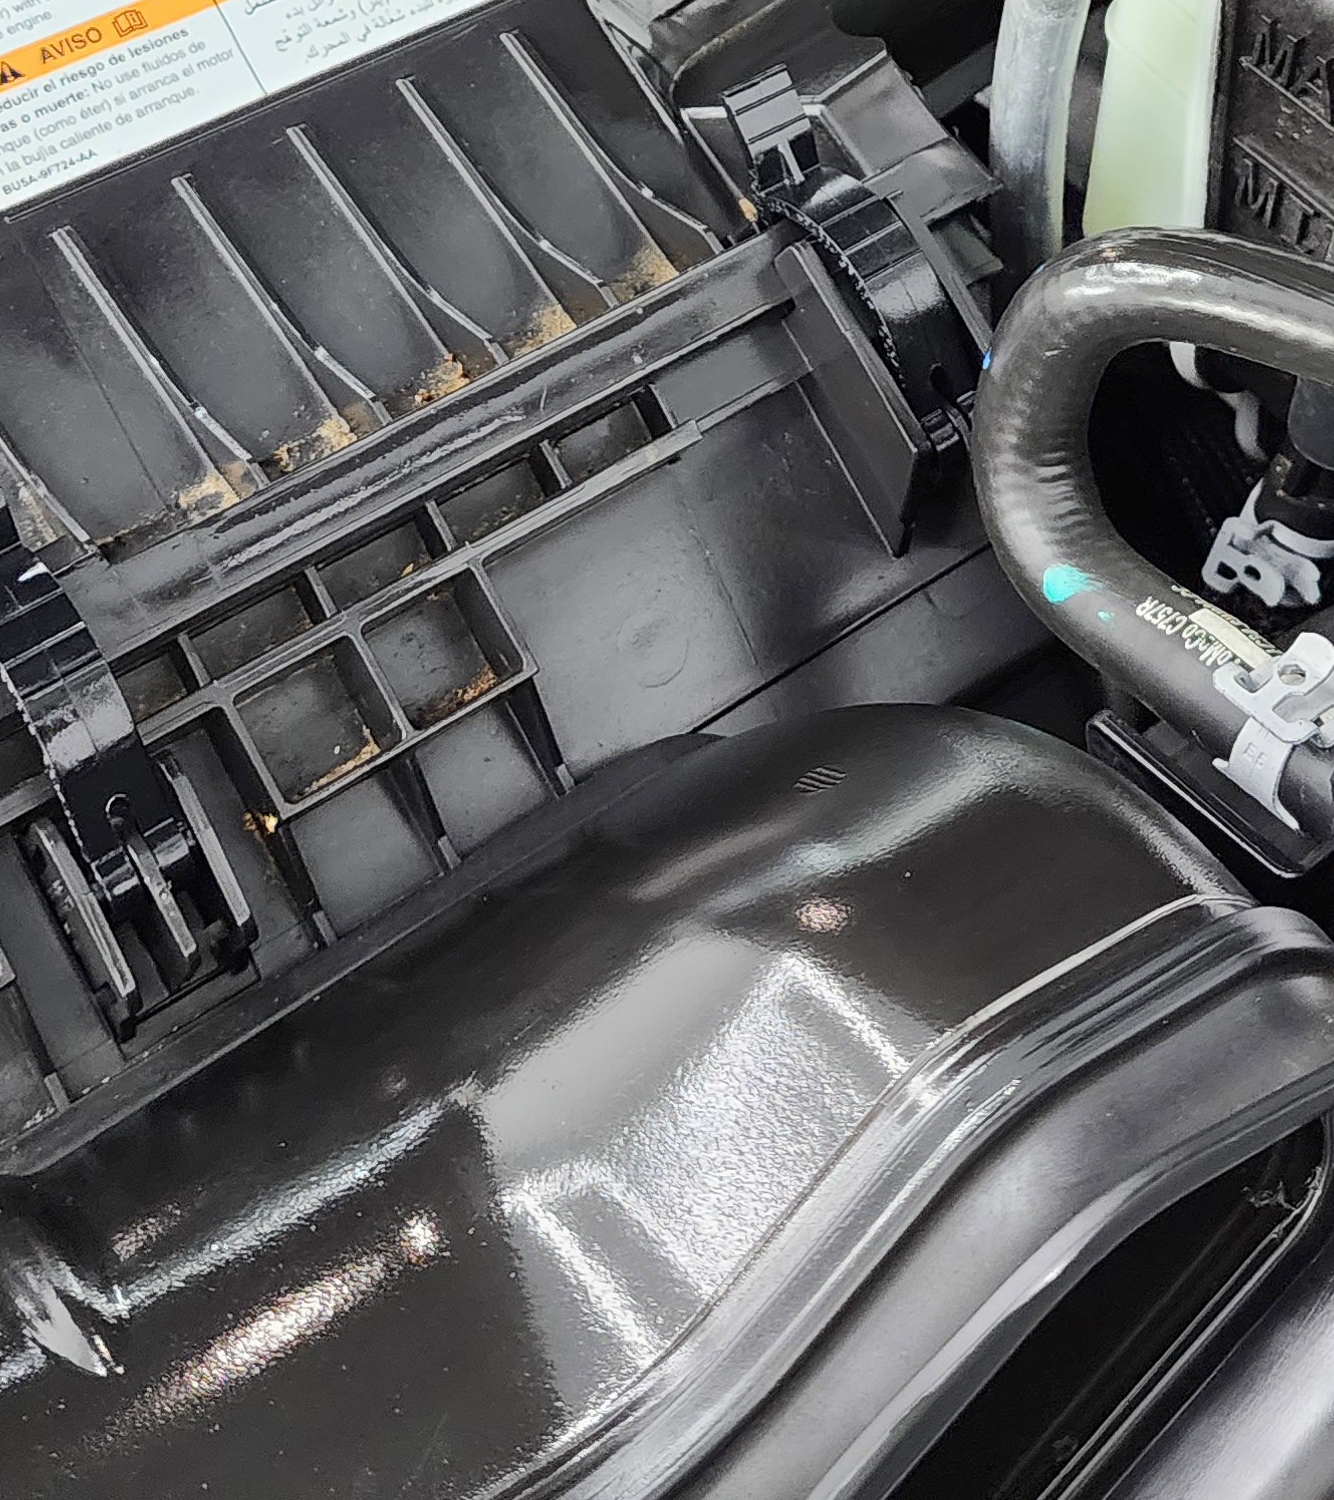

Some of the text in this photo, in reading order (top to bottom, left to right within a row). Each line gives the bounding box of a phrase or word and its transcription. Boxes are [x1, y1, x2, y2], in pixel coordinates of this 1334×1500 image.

[38, 25, 103, 65] AVISO
[57, 60, 106, 87] riesgo
[125, 26, 190, 59] lesiones
[31, 114, 78, 142] (como
[78, 97, 113, 120] éter)
[127, 71, 181, 101] arranca
[194, 46, 234, 72] motor
[32, 87, 91, 119] muerte:
[113, 67, 141, 85] use
[139, 47, 187, 74] fluidos
[58, 119, 113, 150] caliente
[0, 147, 99, 196] BU5A-9F724-AA
[1133, 594, 1187, 635] C757R
